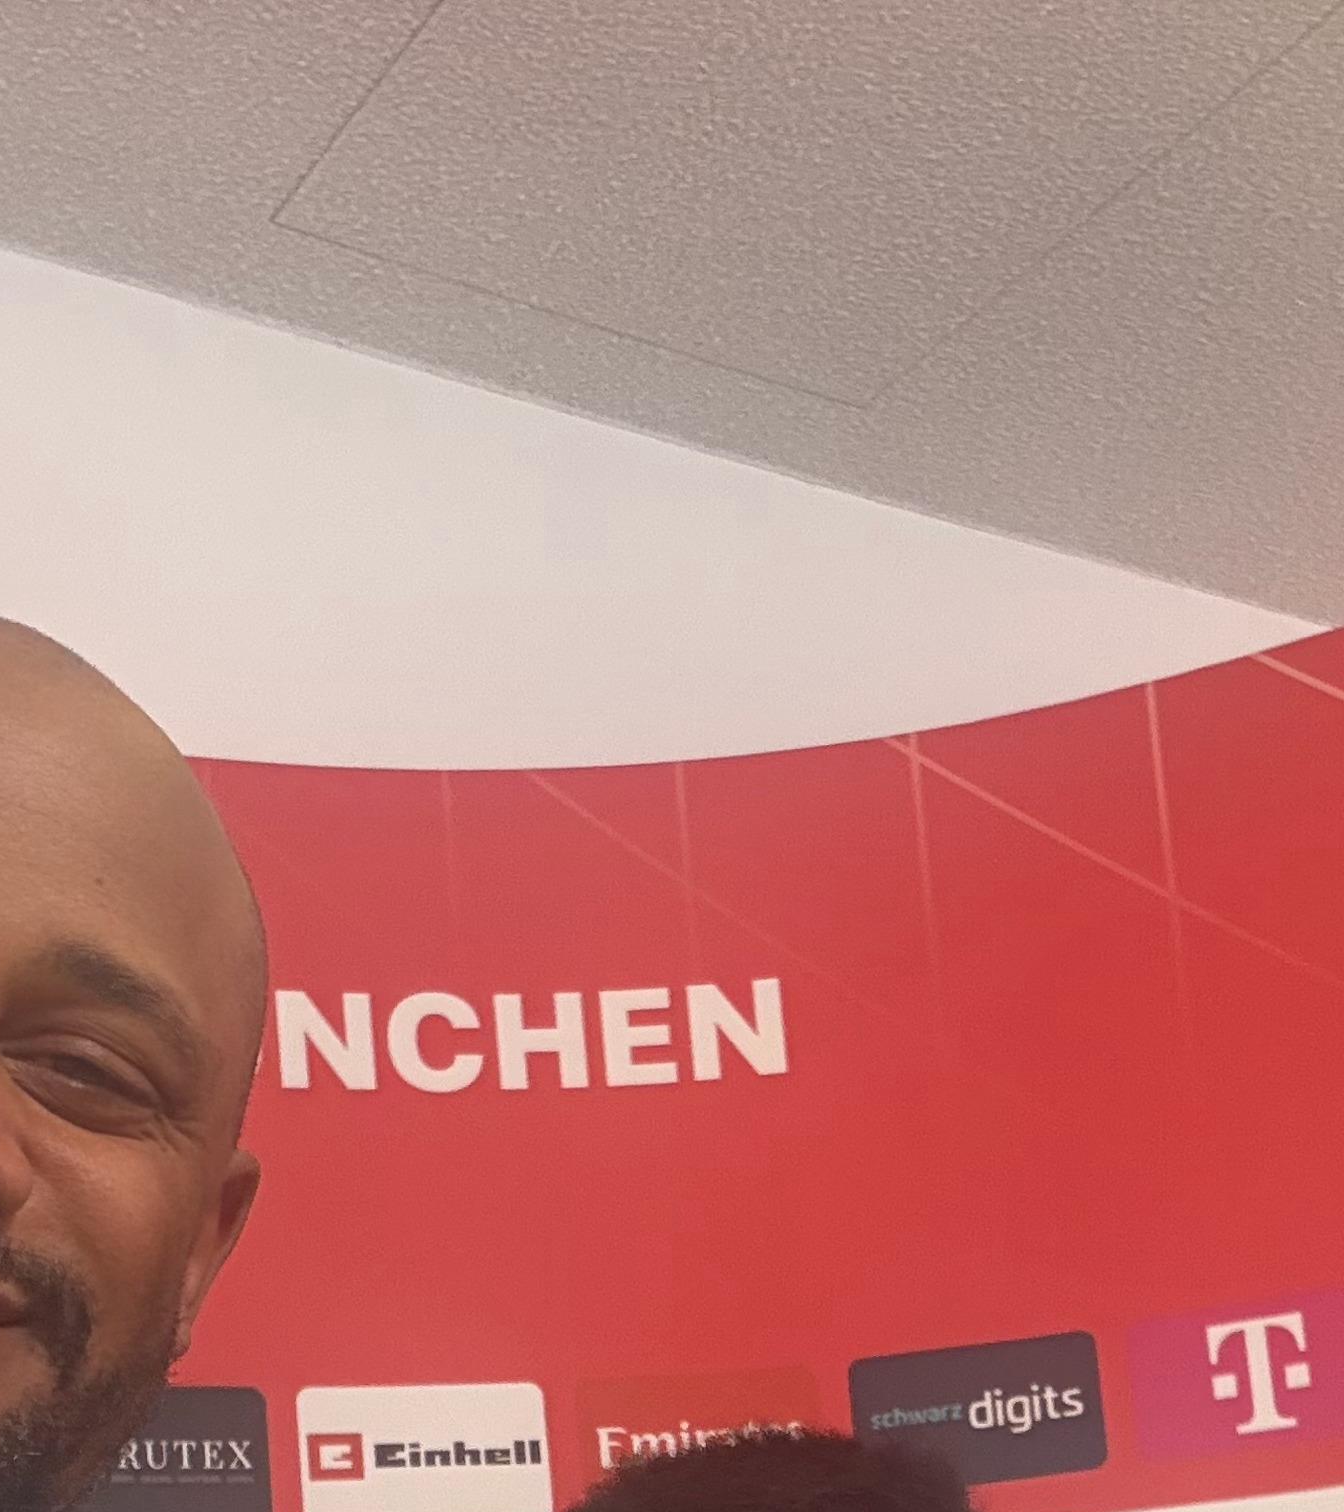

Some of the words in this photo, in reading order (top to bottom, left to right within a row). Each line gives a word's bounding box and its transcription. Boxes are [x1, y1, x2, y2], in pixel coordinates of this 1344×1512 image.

[260, 977, 789, 1093] NCHEN
[869, 1403, 964, 1431] schwarz
[967, 1382, 1085, 1435] digits
[1205, 1310, 1312, 1437] T
[373, 1439, 542, 1469] Einhell
